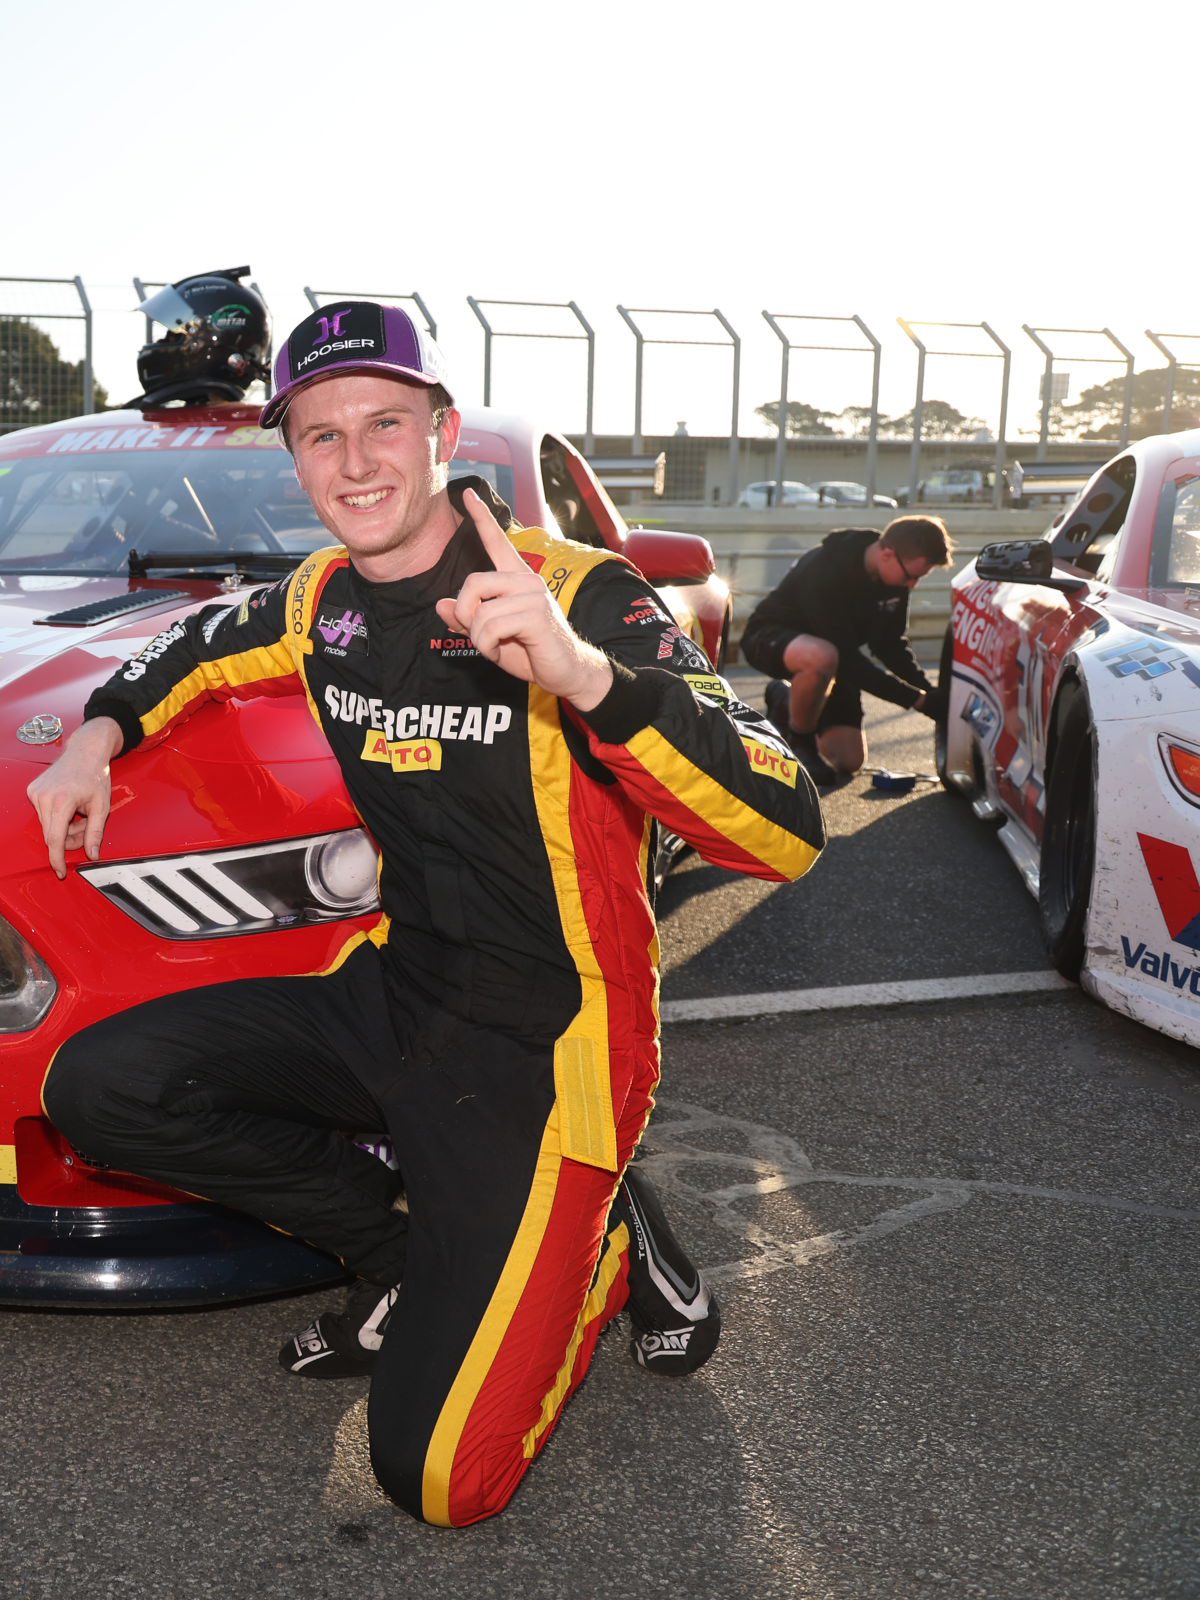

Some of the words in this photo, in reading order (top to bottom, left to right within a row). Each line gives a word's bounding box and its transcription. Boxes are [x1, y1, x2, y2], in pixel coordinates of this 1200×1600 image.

[297, 338, 375, 371] HOOSIER
[47, 427, 175, 453] MAKE
[170, 426, 227, 448] IT
[293, 563, 317, 635] sparco
[318, 614, 368, 640] HOOSIE
[324, 645, 347, 658] mobile
[324, 684, 512, 745] SUPERCHEAP
[372, 738, 432, 765] ATO
